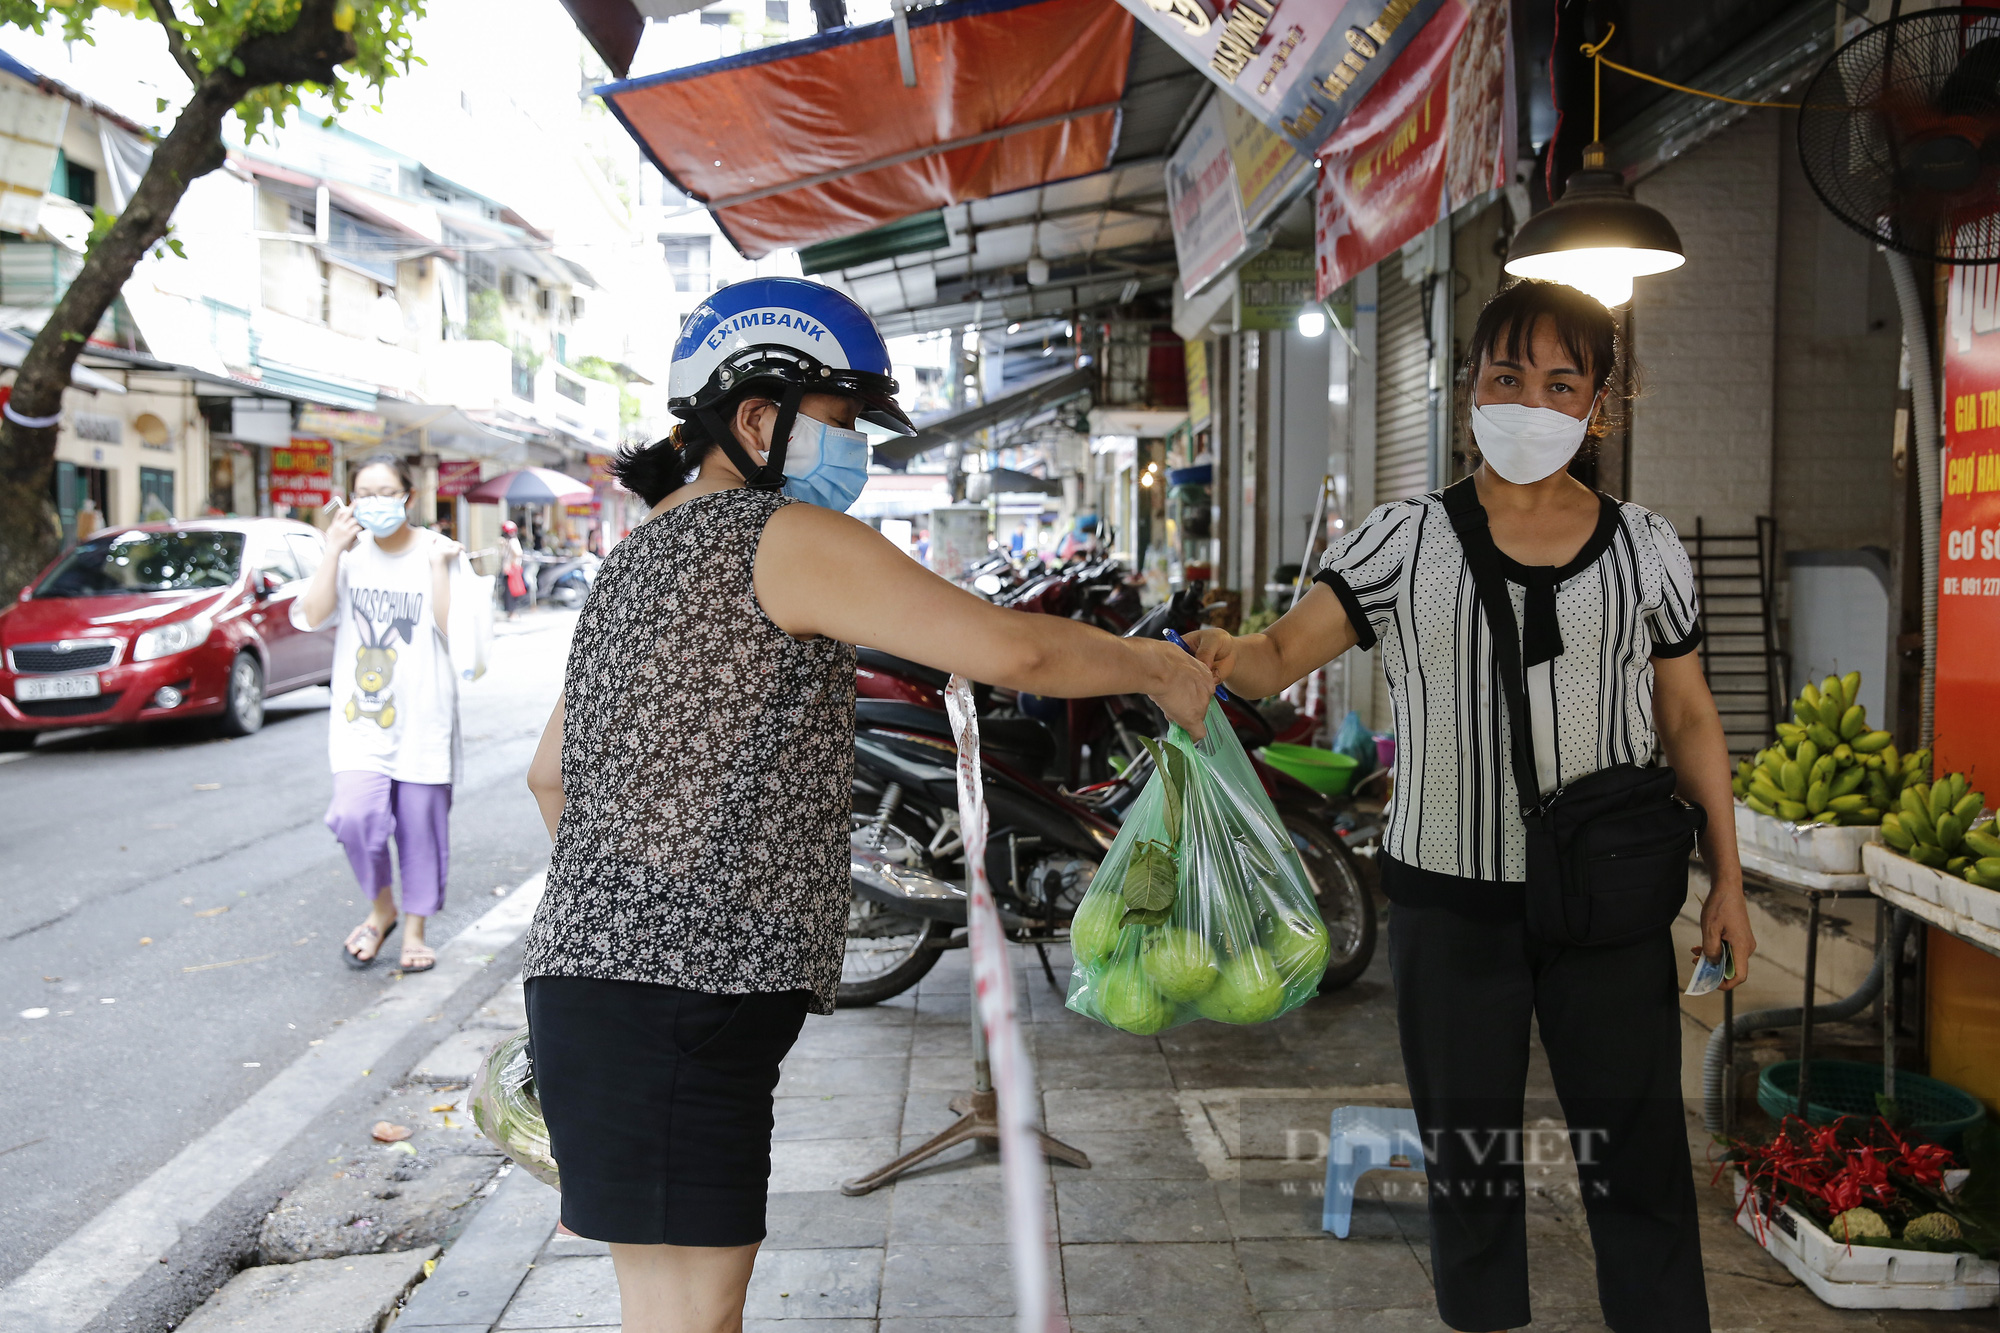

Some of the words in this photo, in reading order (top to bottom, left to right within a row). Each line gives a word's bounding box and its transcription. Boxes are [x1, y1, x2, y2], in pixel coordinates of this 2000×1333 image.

[706, 312, 826, 350] EXIMBANK
[1955, 393, 1977, 433] GIA
[1947, 451, 1976, 501] CHỢ
[1948, 525, 1977, 561] CƠ
[1961, 577, 1981, 596] 091
